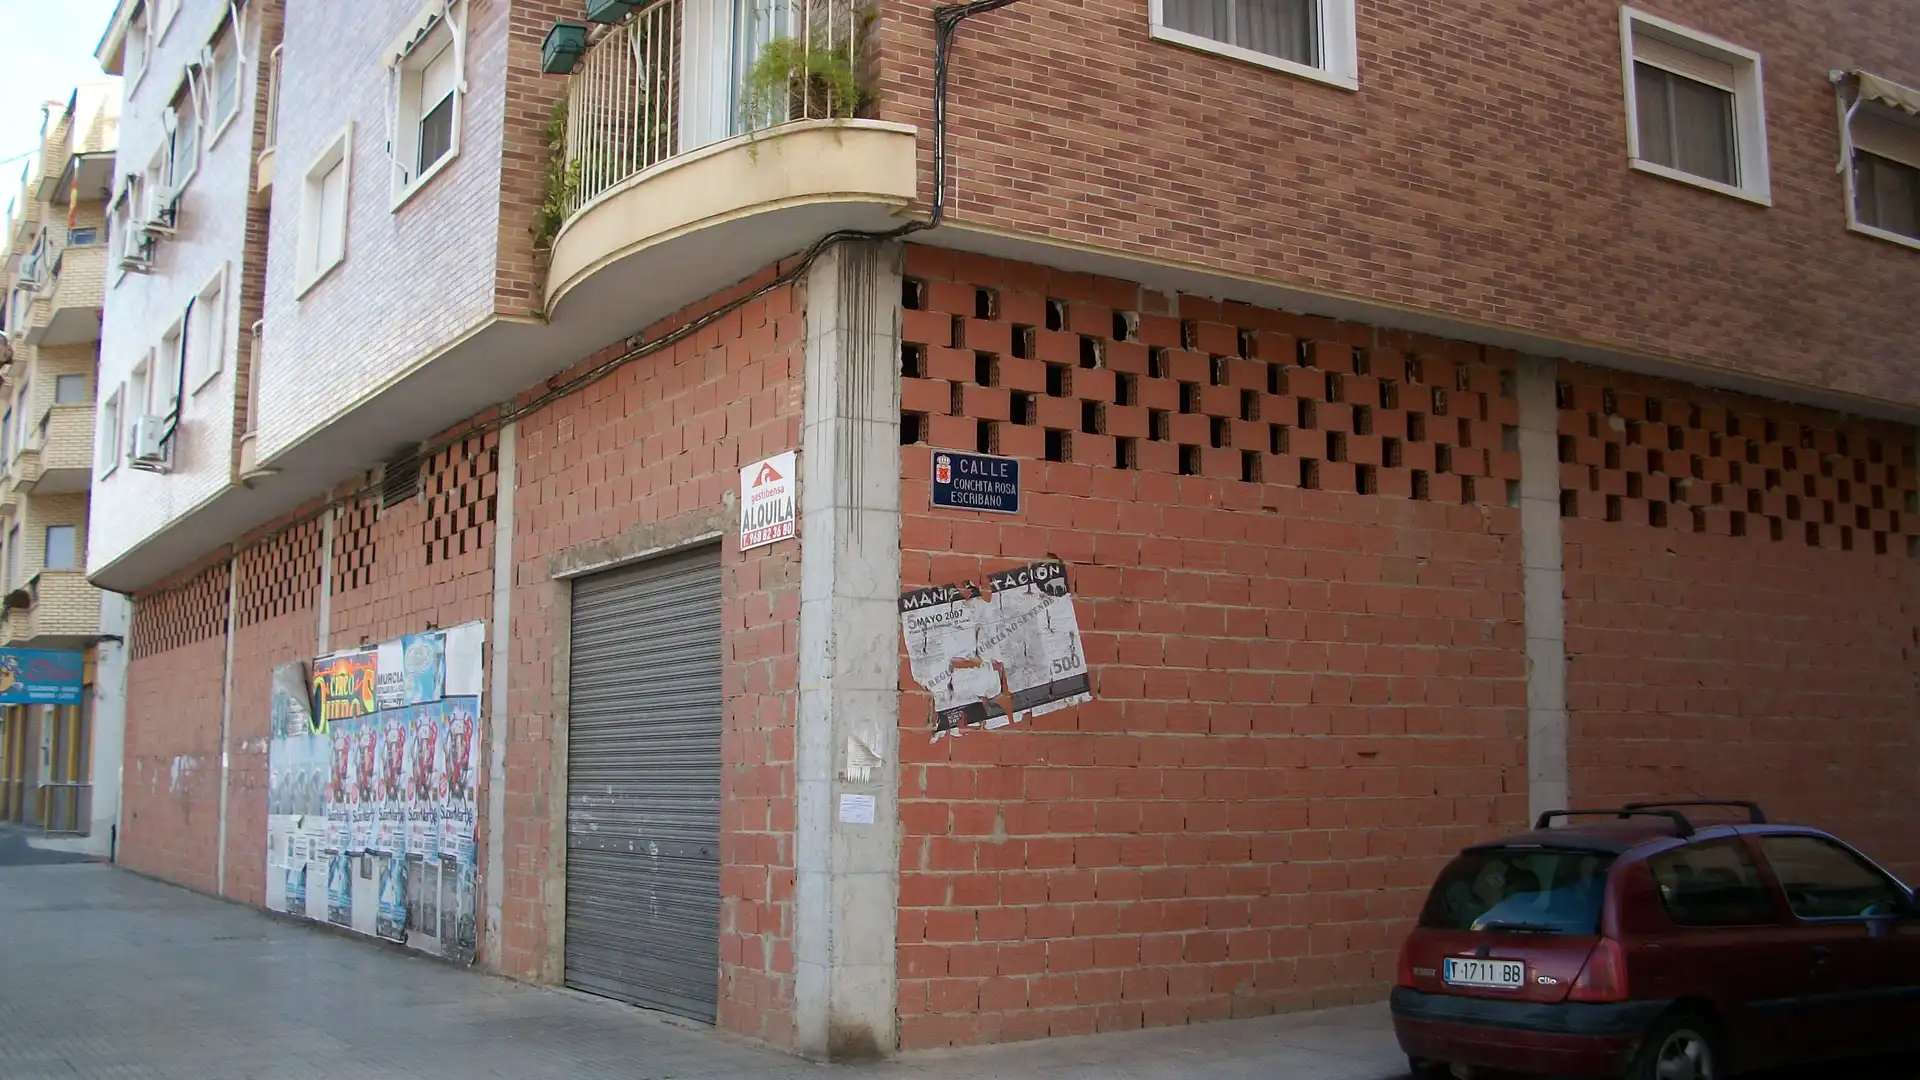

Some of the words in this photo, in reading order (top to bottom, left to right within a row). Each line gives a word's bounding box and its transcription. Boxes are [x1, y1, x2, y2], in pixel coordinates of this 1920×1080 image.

[960, 459, 1008, 477] CALLE
[751, 485, 785, 505] gestibensa
[953, 478, 993, 493] CONCHITA
[995, 482, 1016, 495] ROSA
[951, 491, 1001, 506] ESCRIBANO
[743, 496, 793, 533] ALQUILA
[907, 614, 917, 630] 5
[917, 614, 942, 627] MAYO
[944, 609, 963, 620] 2007
[1053, 653, 1080, 674] 500
[378, 672, 404, 685] MURCIA
[1537, 976, 1556, 984] Clio
